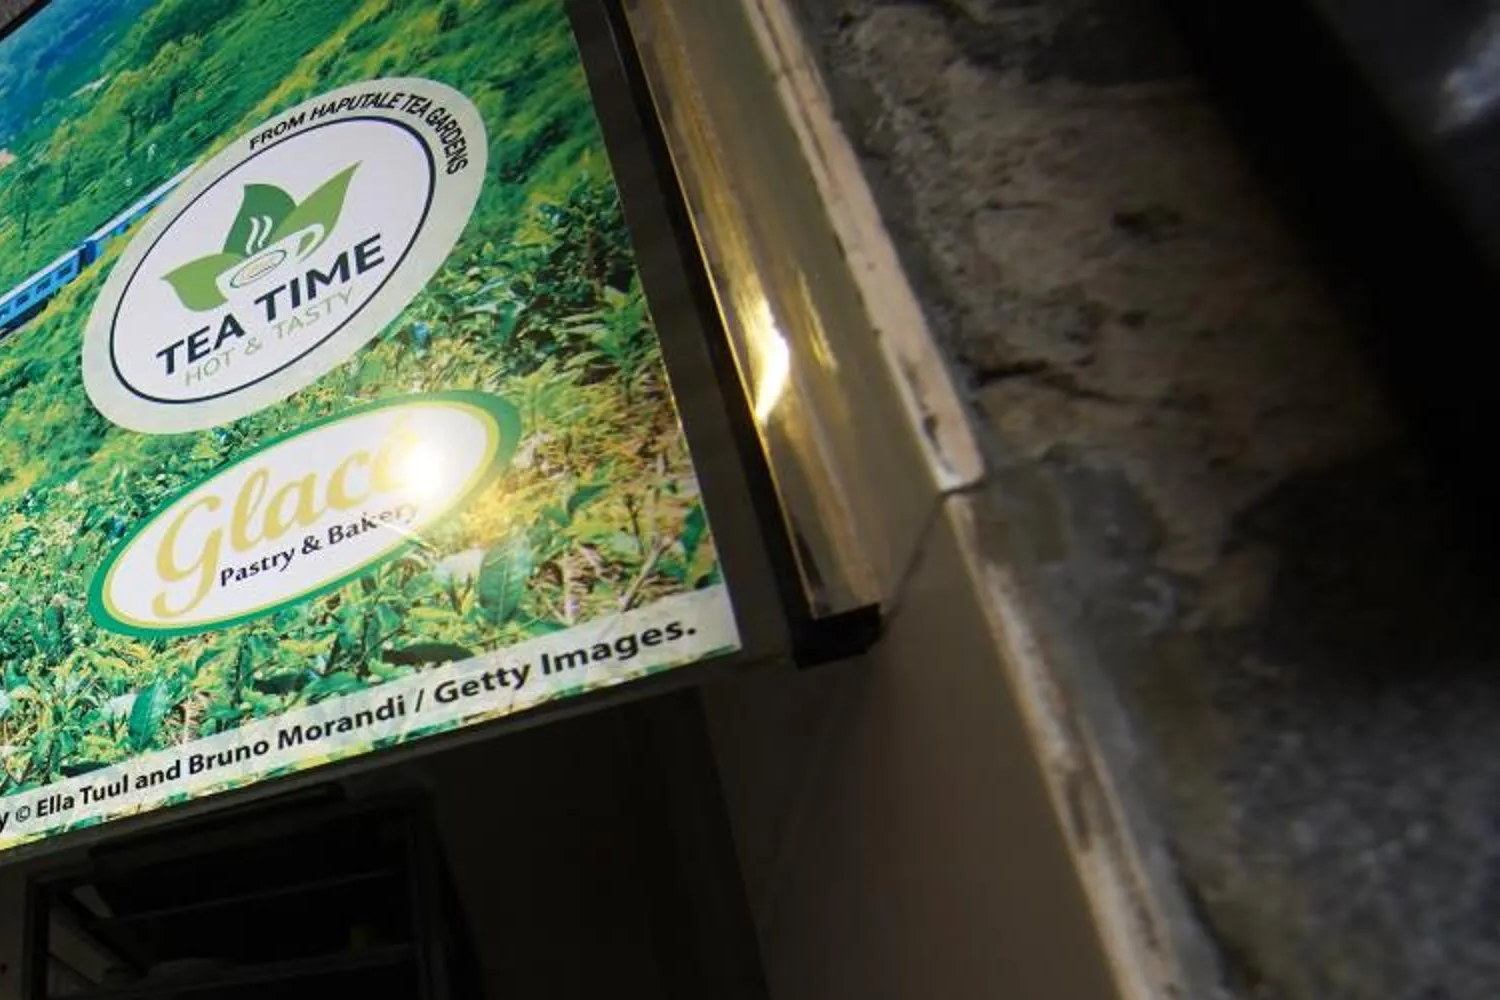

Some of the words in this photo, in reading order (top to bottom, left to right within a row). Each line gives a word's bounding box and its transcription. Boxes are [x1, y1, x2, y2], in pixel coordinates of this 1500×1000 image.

[249, 112, 305, 149] FROM
[310, 92, 402, 121] HAPUTALE
[400, 93, 432, 118] TEA
[426, 107, 468, 175] GARDENS
[156, 312, 245, 375] TEA
[255, 233, 385, 322] TIME
[184, 346, 235, 387] HOT
[244, 337, 263, 355] &
[272, 287, 354, 335] TASTY
[220, 546, 296, 587] Pastry
[300, 535, 323, 557] &
[36, 793, 75, 818] Ella
[80, 773, 129, 806] Tuul
[135, 760, 182, 790] and
[188, 740, 270, 775] Bruno
[277, 694, 407, 747] Morandi
[414, 687, 425, 712] /
[433, 660, 532, 704] Getty
[541, 617, 697, 677] Images.
